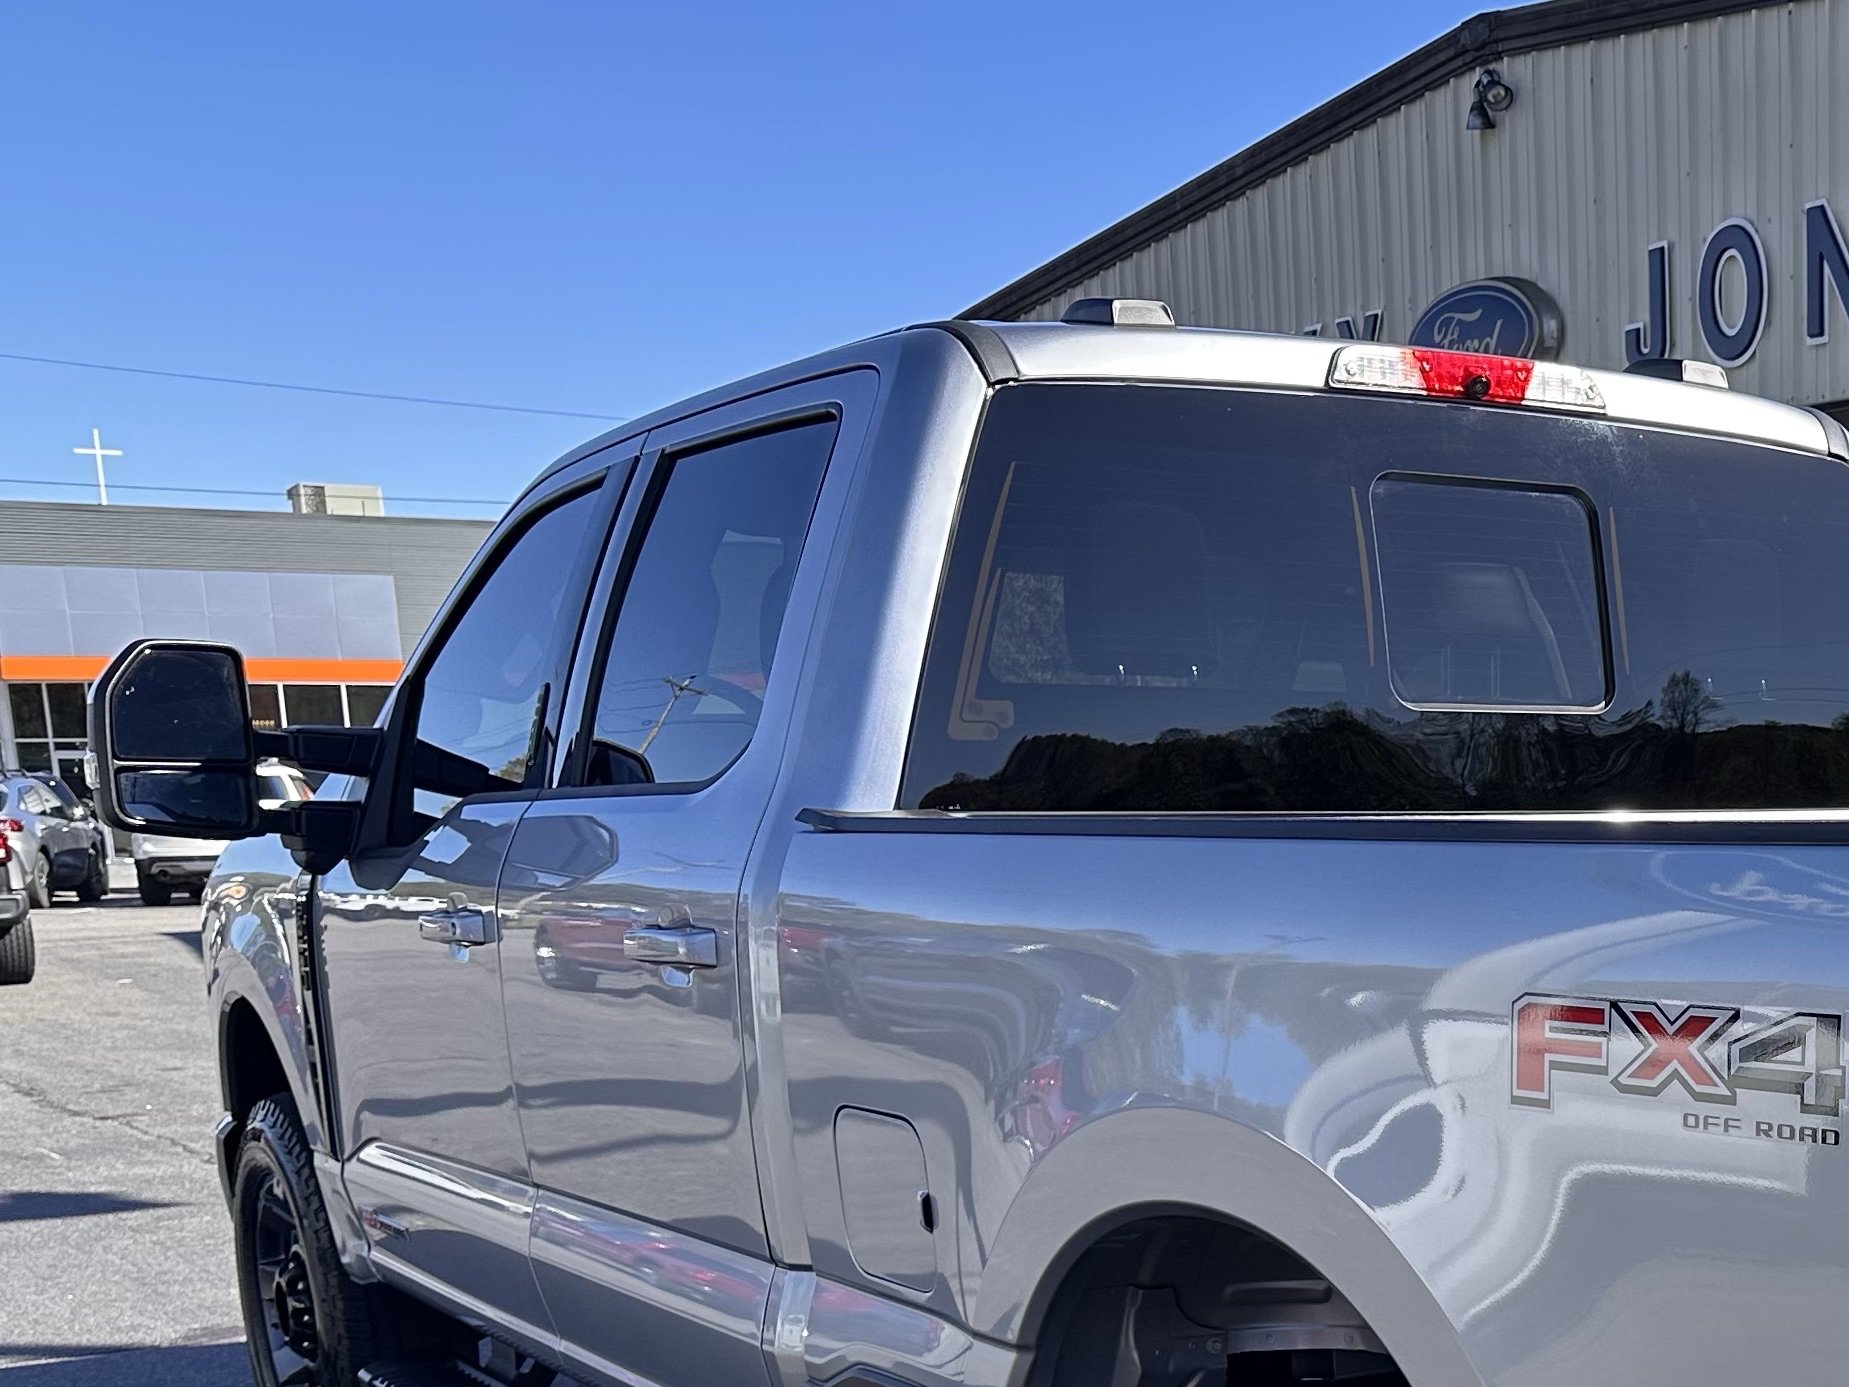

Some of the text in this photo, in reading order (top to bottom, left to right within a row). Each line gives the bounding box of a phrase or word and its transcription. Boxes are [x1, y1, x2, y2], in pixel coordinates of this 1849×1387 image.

[1510, 991, 1846, 1118] FX4
[1682, 1112, 1841, 1147] OFF ROAD
